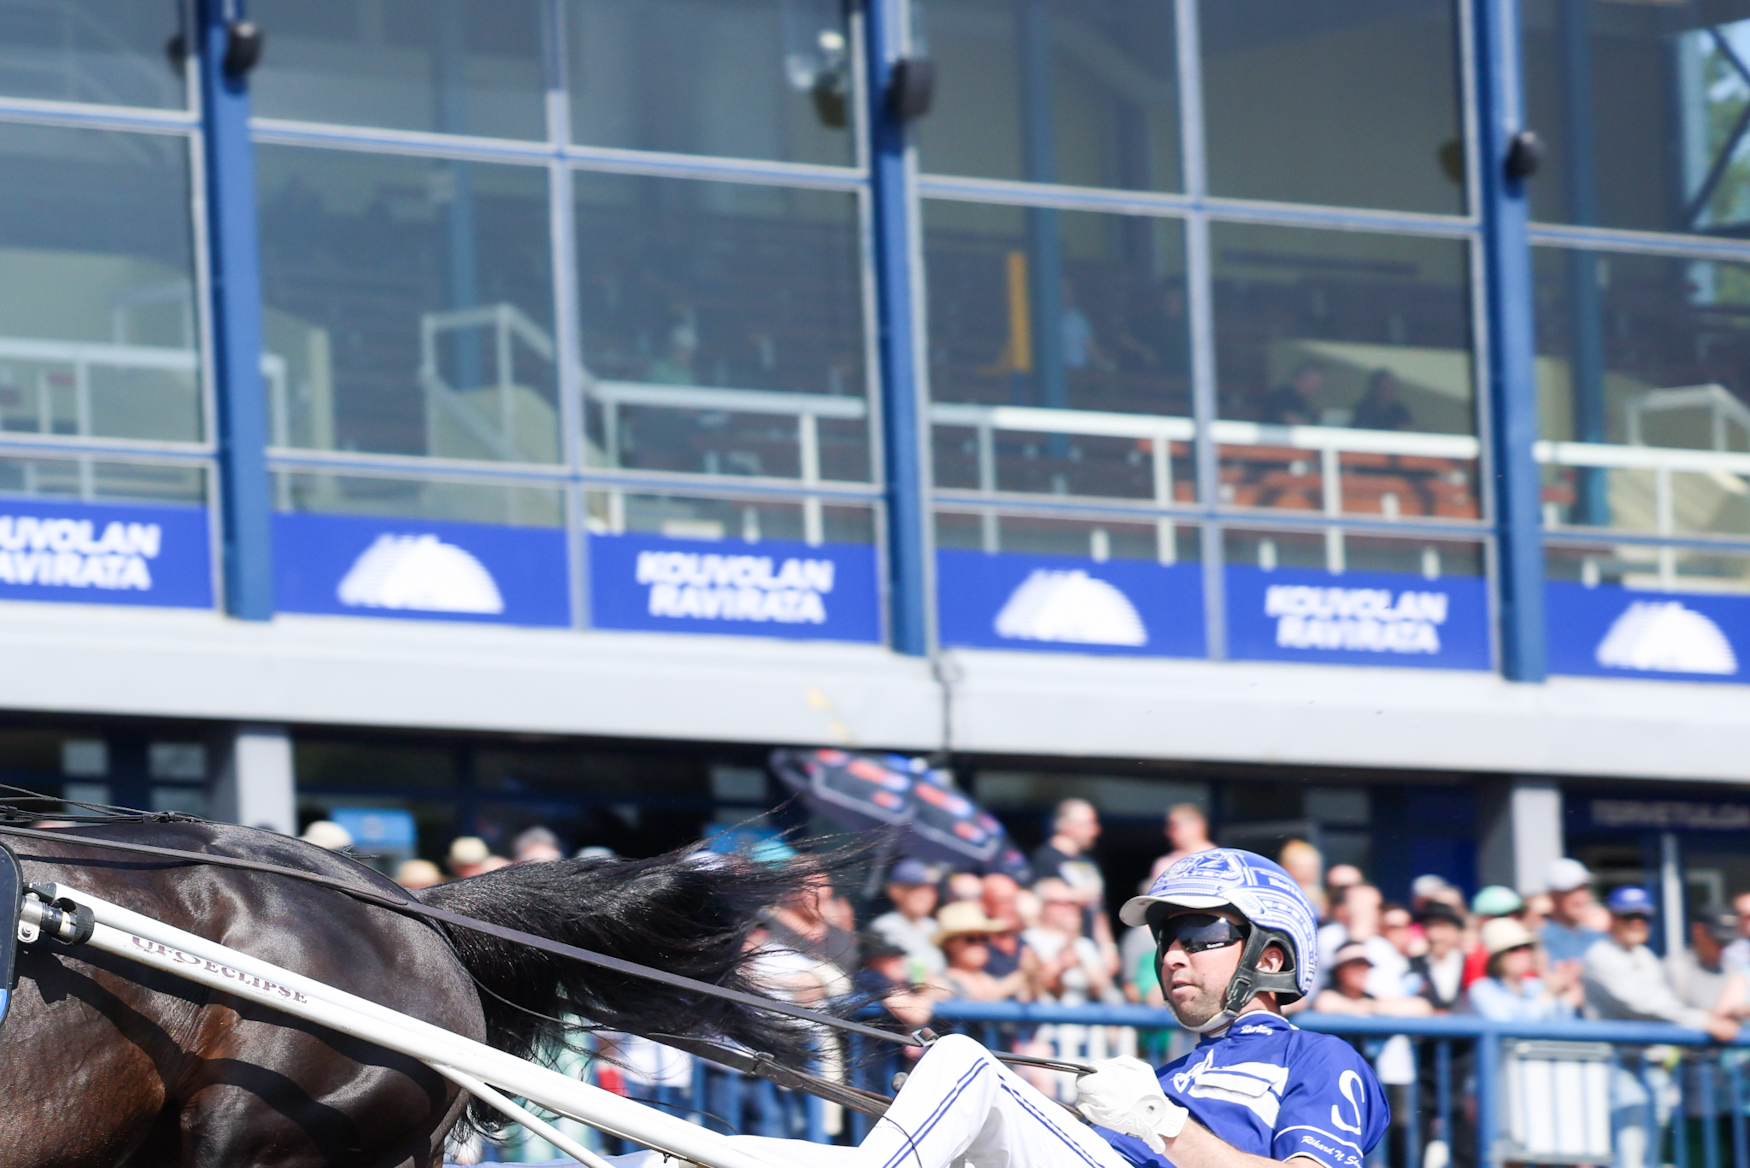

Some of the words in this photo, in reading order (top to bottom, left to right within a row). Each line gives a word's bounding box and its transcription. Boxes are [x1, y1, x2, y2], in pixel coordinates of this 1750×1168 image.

[636, 551, 834, 593] KOUVOLAN
[649, 585, 826, 623] RAVIRATA
[1265, 585, 1447, 624] KOUVOLAN
